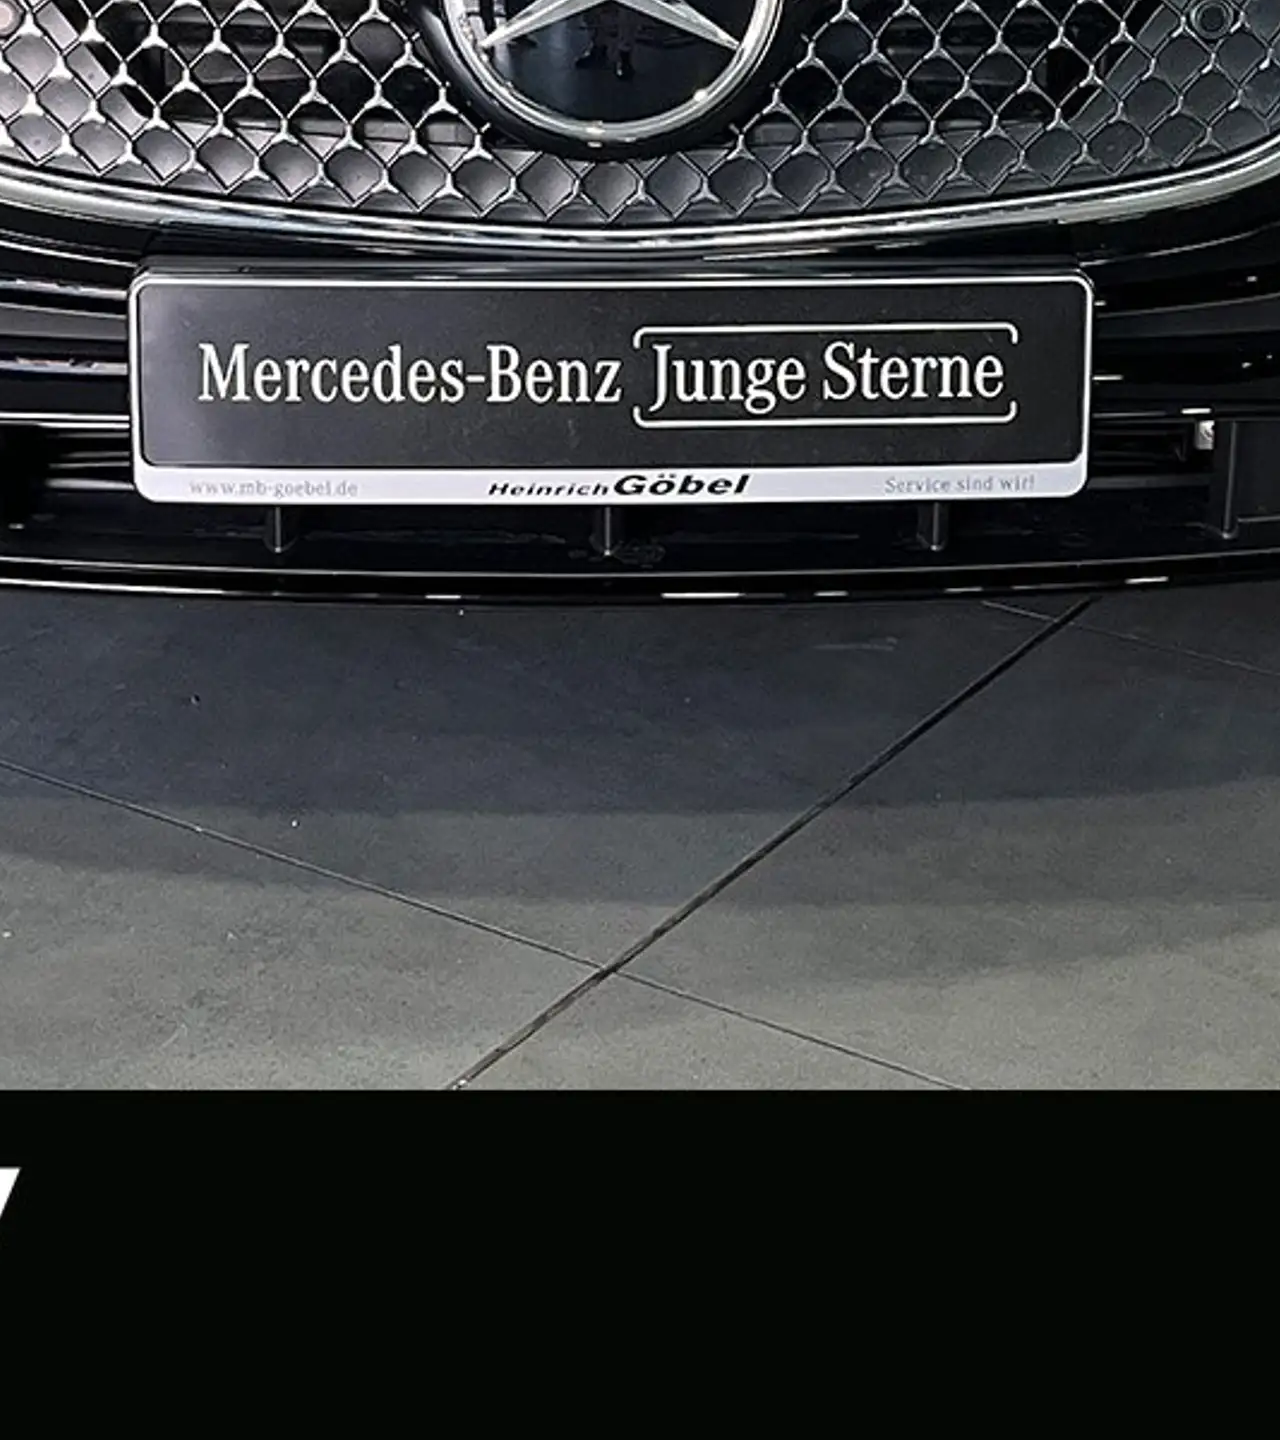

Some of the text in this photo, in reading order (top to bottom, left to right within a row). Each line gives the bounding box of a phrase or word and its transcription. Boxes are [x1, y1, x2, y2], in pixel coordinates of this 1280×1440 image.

[198, 341, 1005, 416] Mercedes-Benz Junge Sterne
[487, 473, 751, 496] Heinrich Göbel
[884, 476, 951, 494] Service
[956, 475, 993, 491] sind
